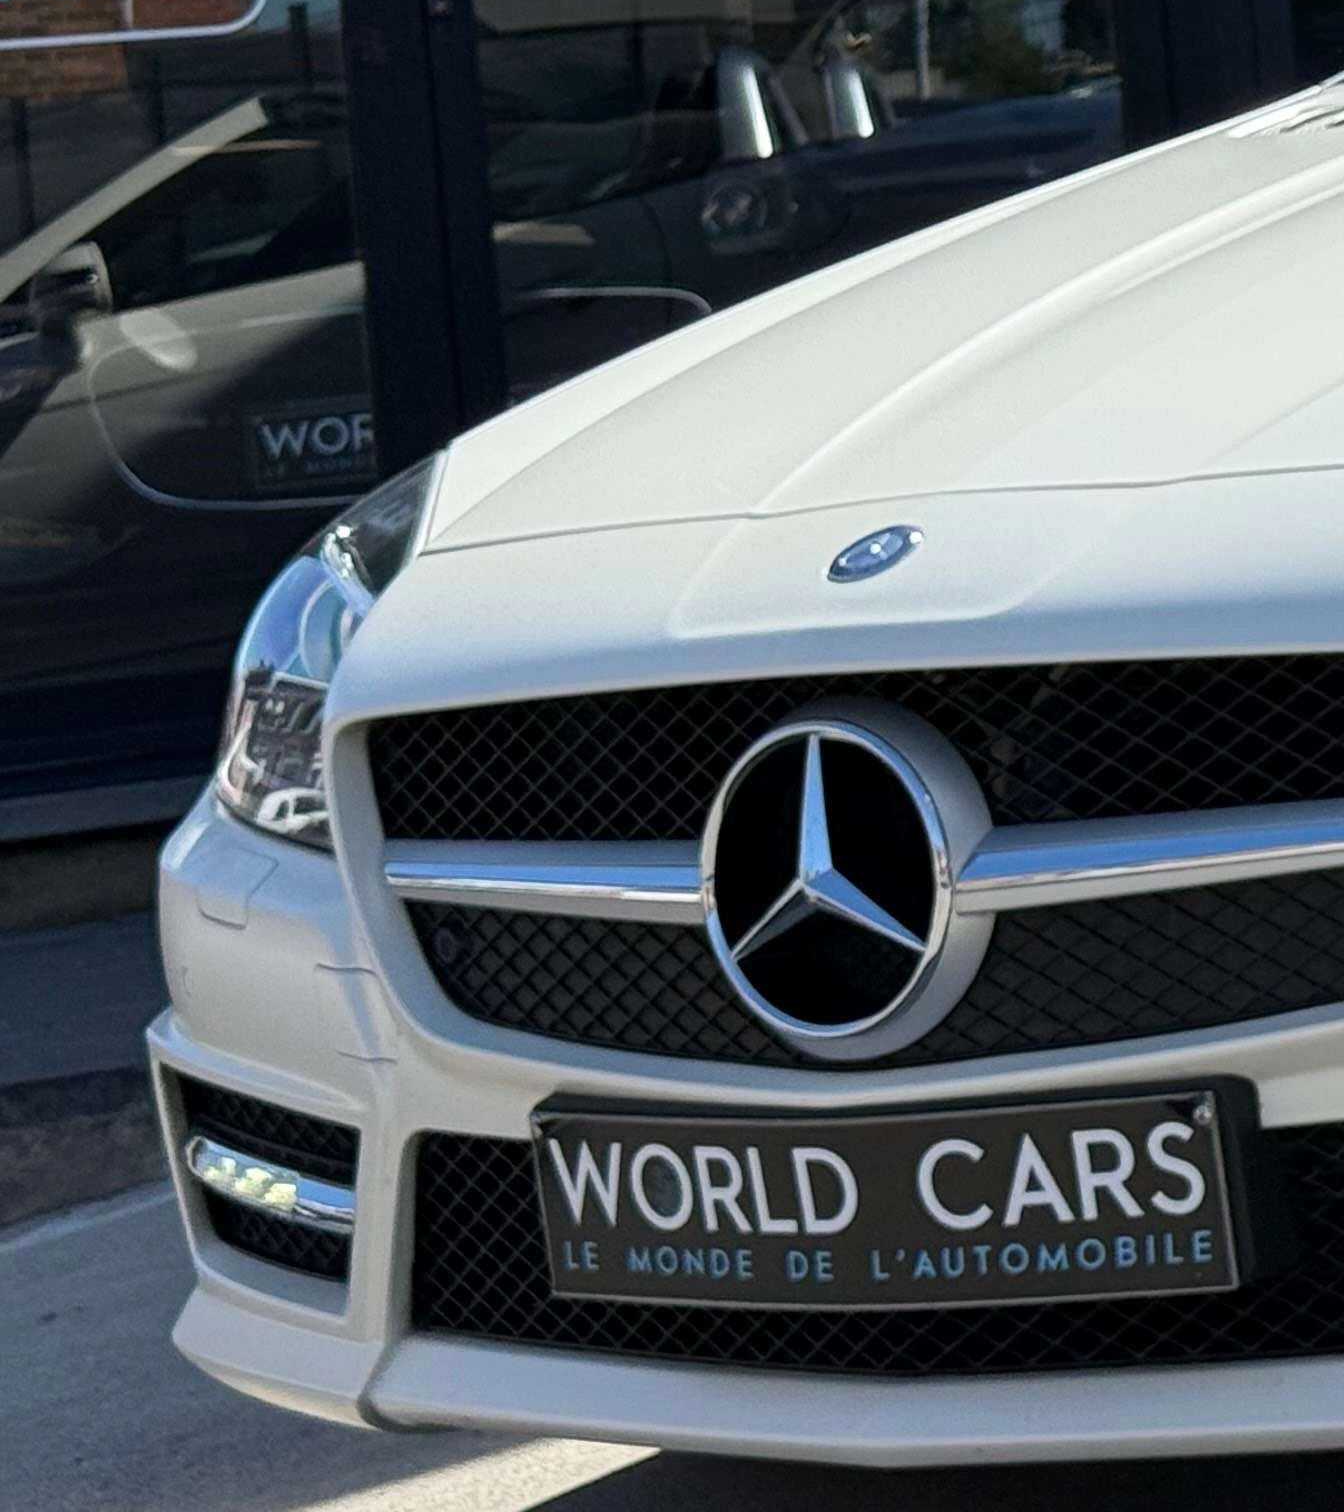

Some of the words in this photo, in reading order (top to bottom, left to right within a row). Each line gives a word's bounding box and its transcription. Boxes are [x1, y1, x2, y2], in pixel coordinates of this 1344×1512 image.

[549, 1138, 858, 1235] WORLD
[917, 1120, 1206, 1231] CARS
[563, 1240, 599, 1272] LE
[626, 1243, 754, 1280] MONDE
[787, 1249, 836, 1282] DE
[871, 1229, 1214, 1283] L'AUTOMOBILE
